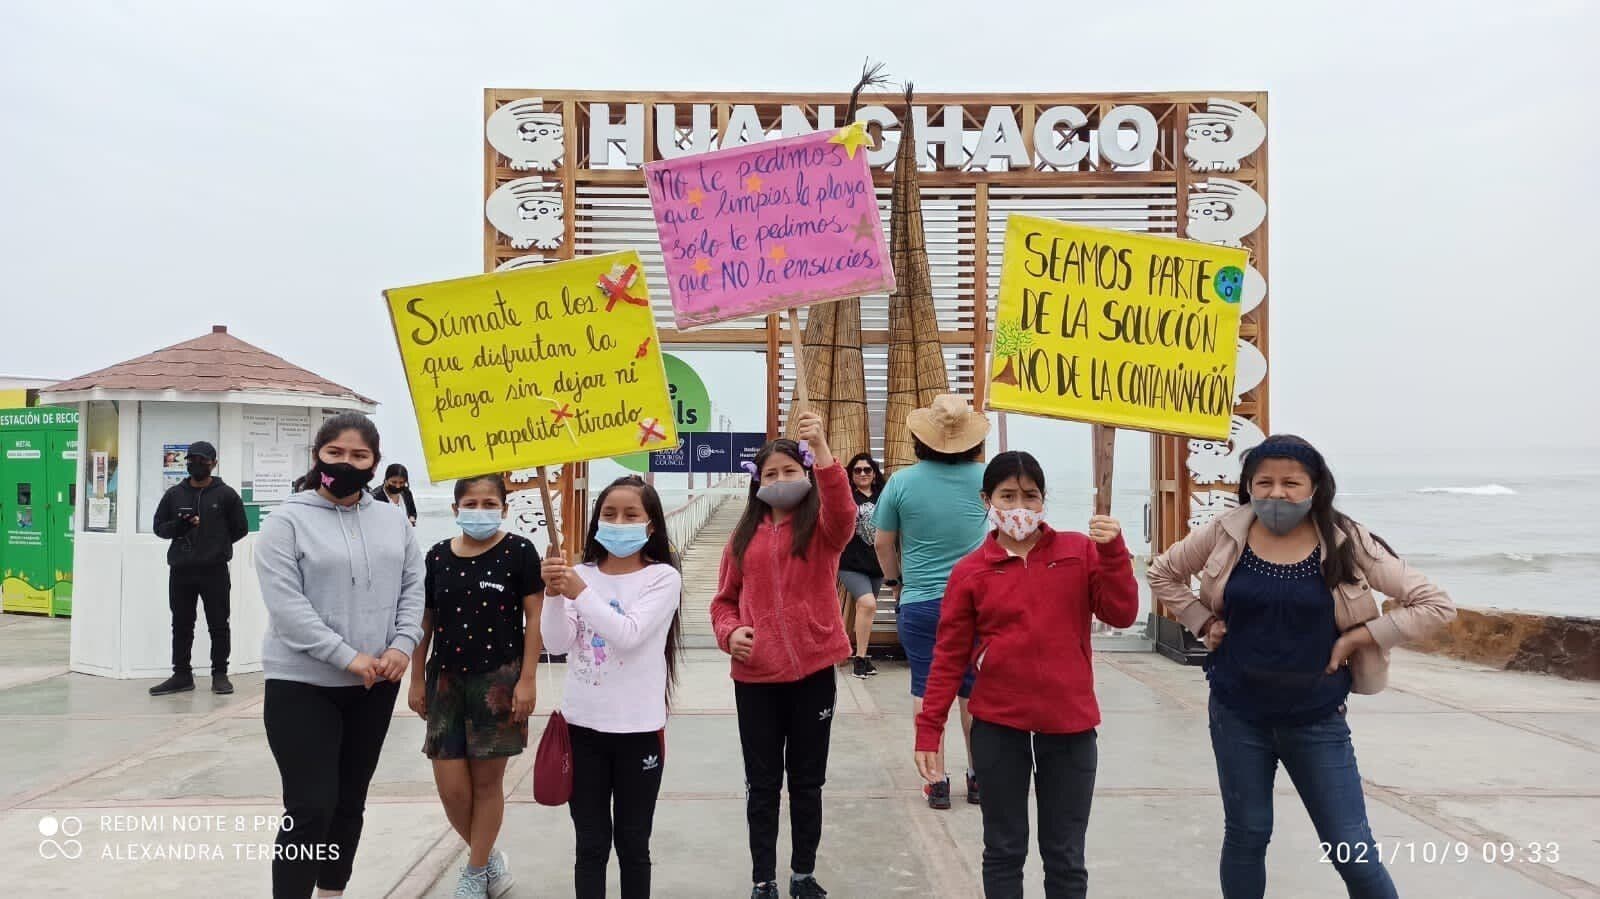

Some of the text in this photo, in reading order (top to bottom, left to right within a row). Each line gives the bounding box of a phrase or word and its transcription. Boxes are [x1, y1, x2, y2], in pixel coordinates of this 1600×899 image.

[697, 161, 725, 193] te
[736, 144, 843, 189] pedimos
[663, 170, 868, 233] que limpies la playa
[673, 214, 849, 260] sólo te pedimos
[678, 248, 881, 303] que NO la ensucies
[1024, 231, 1213, 304] SEAMOS PARTE
[406, 285, 599, 346] Súmate a los
[1021, 287, 1053, 335] DE
[1061, 294, 1089, 340] LA
[420, 324, 617, 388] que disfrutan la
[1017, 347, 1051, 395] NO
[1056, 352, 1082, 398] DE
[1090, 357, 1113, 402] LA
[0, 411, 80, 426] ESTACIÓN DE RECIC
[432, 361, 640, 422] playa sin dejar ni
[438, 399, 643, 461] un papelito tirado
